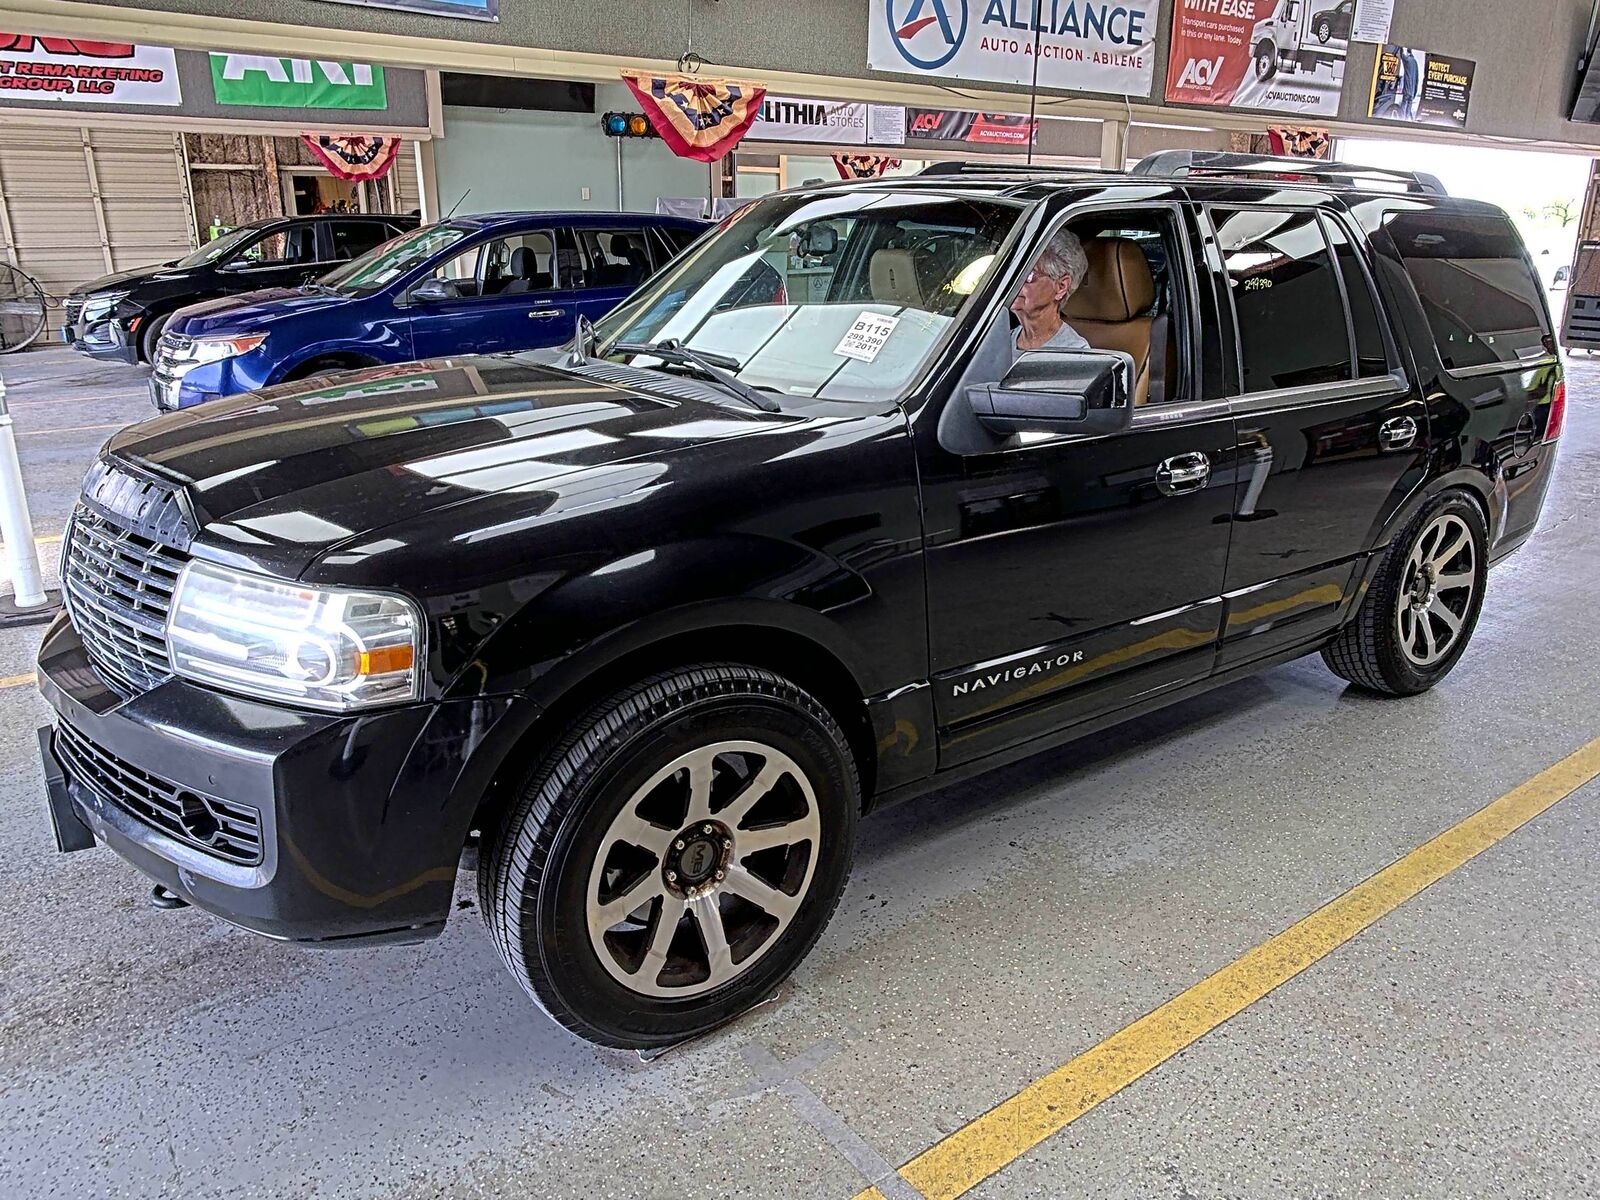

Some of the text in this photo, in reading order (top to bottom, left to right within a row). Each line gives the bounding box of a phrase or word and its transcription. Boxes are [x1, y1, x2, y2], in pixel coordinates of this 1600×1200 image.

[1184, 0, 1255, 20] WITH EASE.
[982, 0, 1146, 46] ALLIANCE
[1182, 16, 1245, 34] Transport cars purchased
[1181, 27, 1186, 36] in
[1187, 28, 1196, 37] this
[1197, 31, 1204, 39] or
[1203, 32, 1213, 42] any
[980, 37, 1019, 53] AUTO
[1024, 43, 1083, 61] AUCTION
[1093, 52, 1143, 68] ABILENE
[15, 62, 163, 82] REMARKETING
[1176, 56, 1224, 88] ACV
[1429, 61, 1450, 73] PROTECT
[0, 76, 115, 94] GROUP, LLC
[1427, 70, 1467, 85] EVERY PURCHASE
[764, 100, 828, 126] LITHIA
[831, 105, 854, 117] AUTO
[830, 116, 864, 128] STORES
[912, 112, 944, 131] ACV
[1244, 277, 1273, 291] 299390
[854, 321, 891, 336] B115
[855, 341, 878, 352] 2011
[952, 650, 1084, 697] NAVIGATOR
